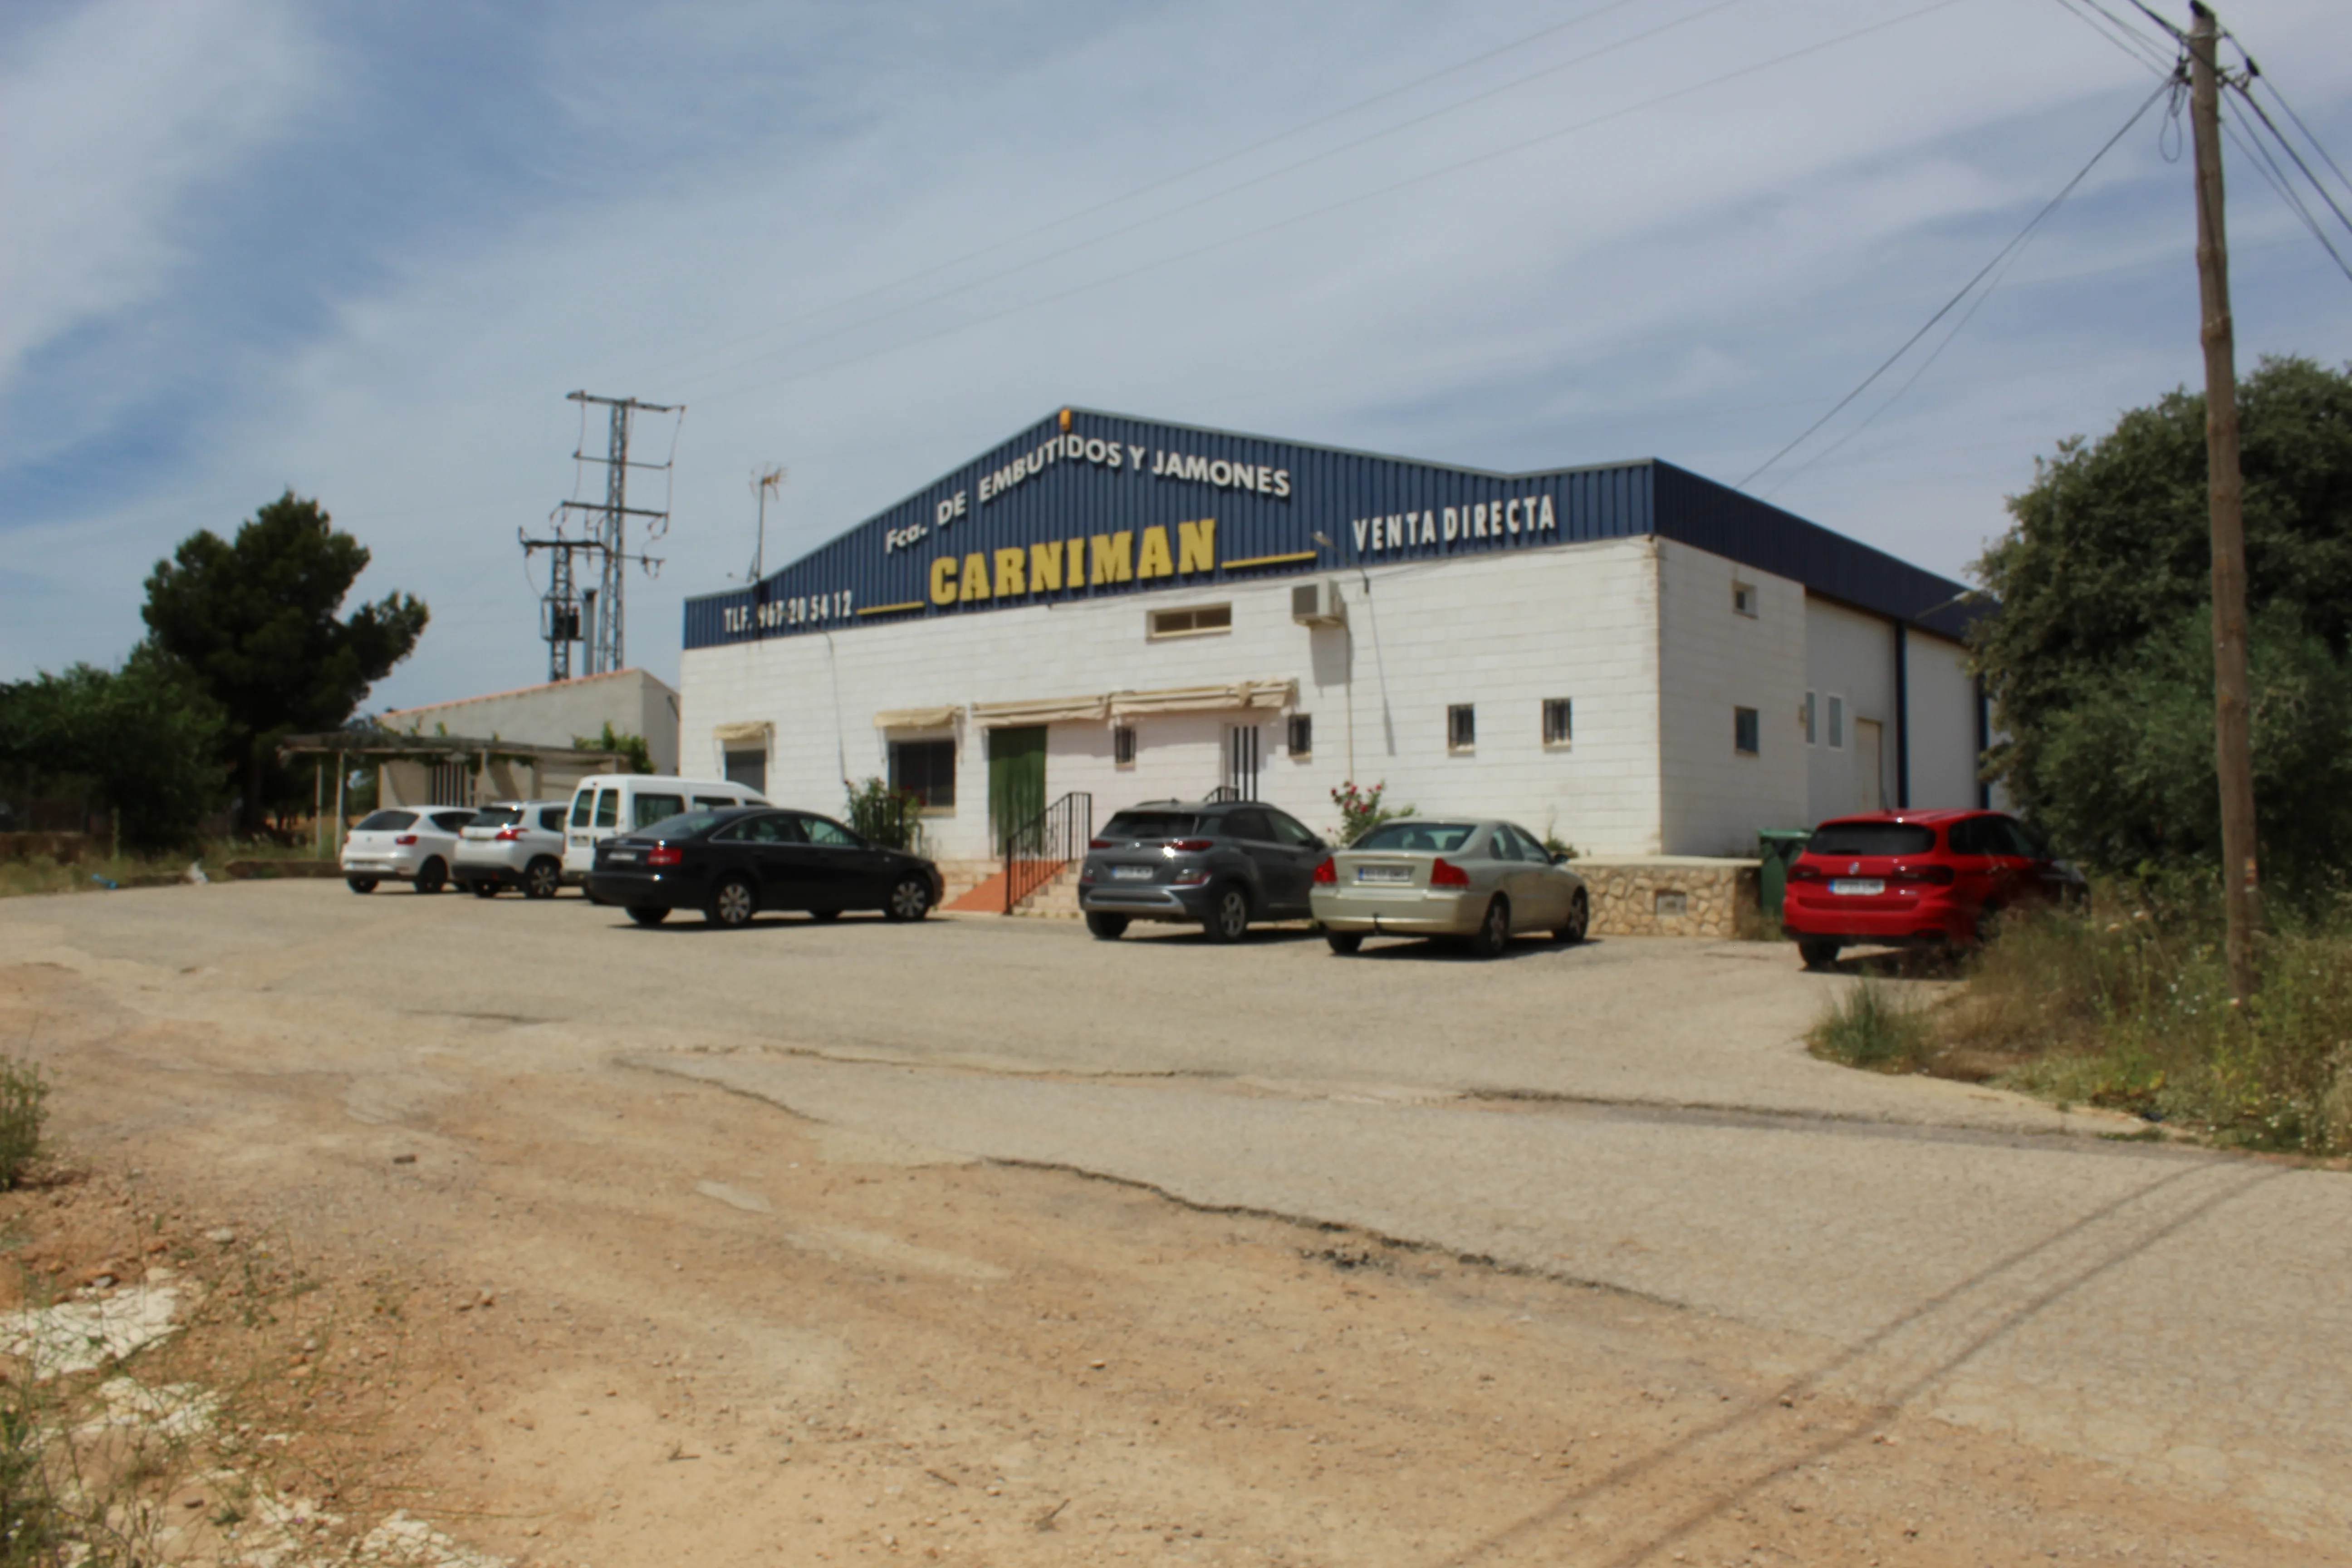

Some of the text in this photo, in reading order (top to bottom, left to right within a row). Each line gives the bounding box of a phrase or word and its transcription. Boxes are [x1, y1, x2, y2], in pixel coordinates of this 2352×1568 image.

[886, 435, 1291, 554] Fca. DE EMBUTIDOS Y JAMONES
[1352, 495, 1555, 552] VENTA DIRECTA
[930, 518, 1216, 605] CARNIMAN
